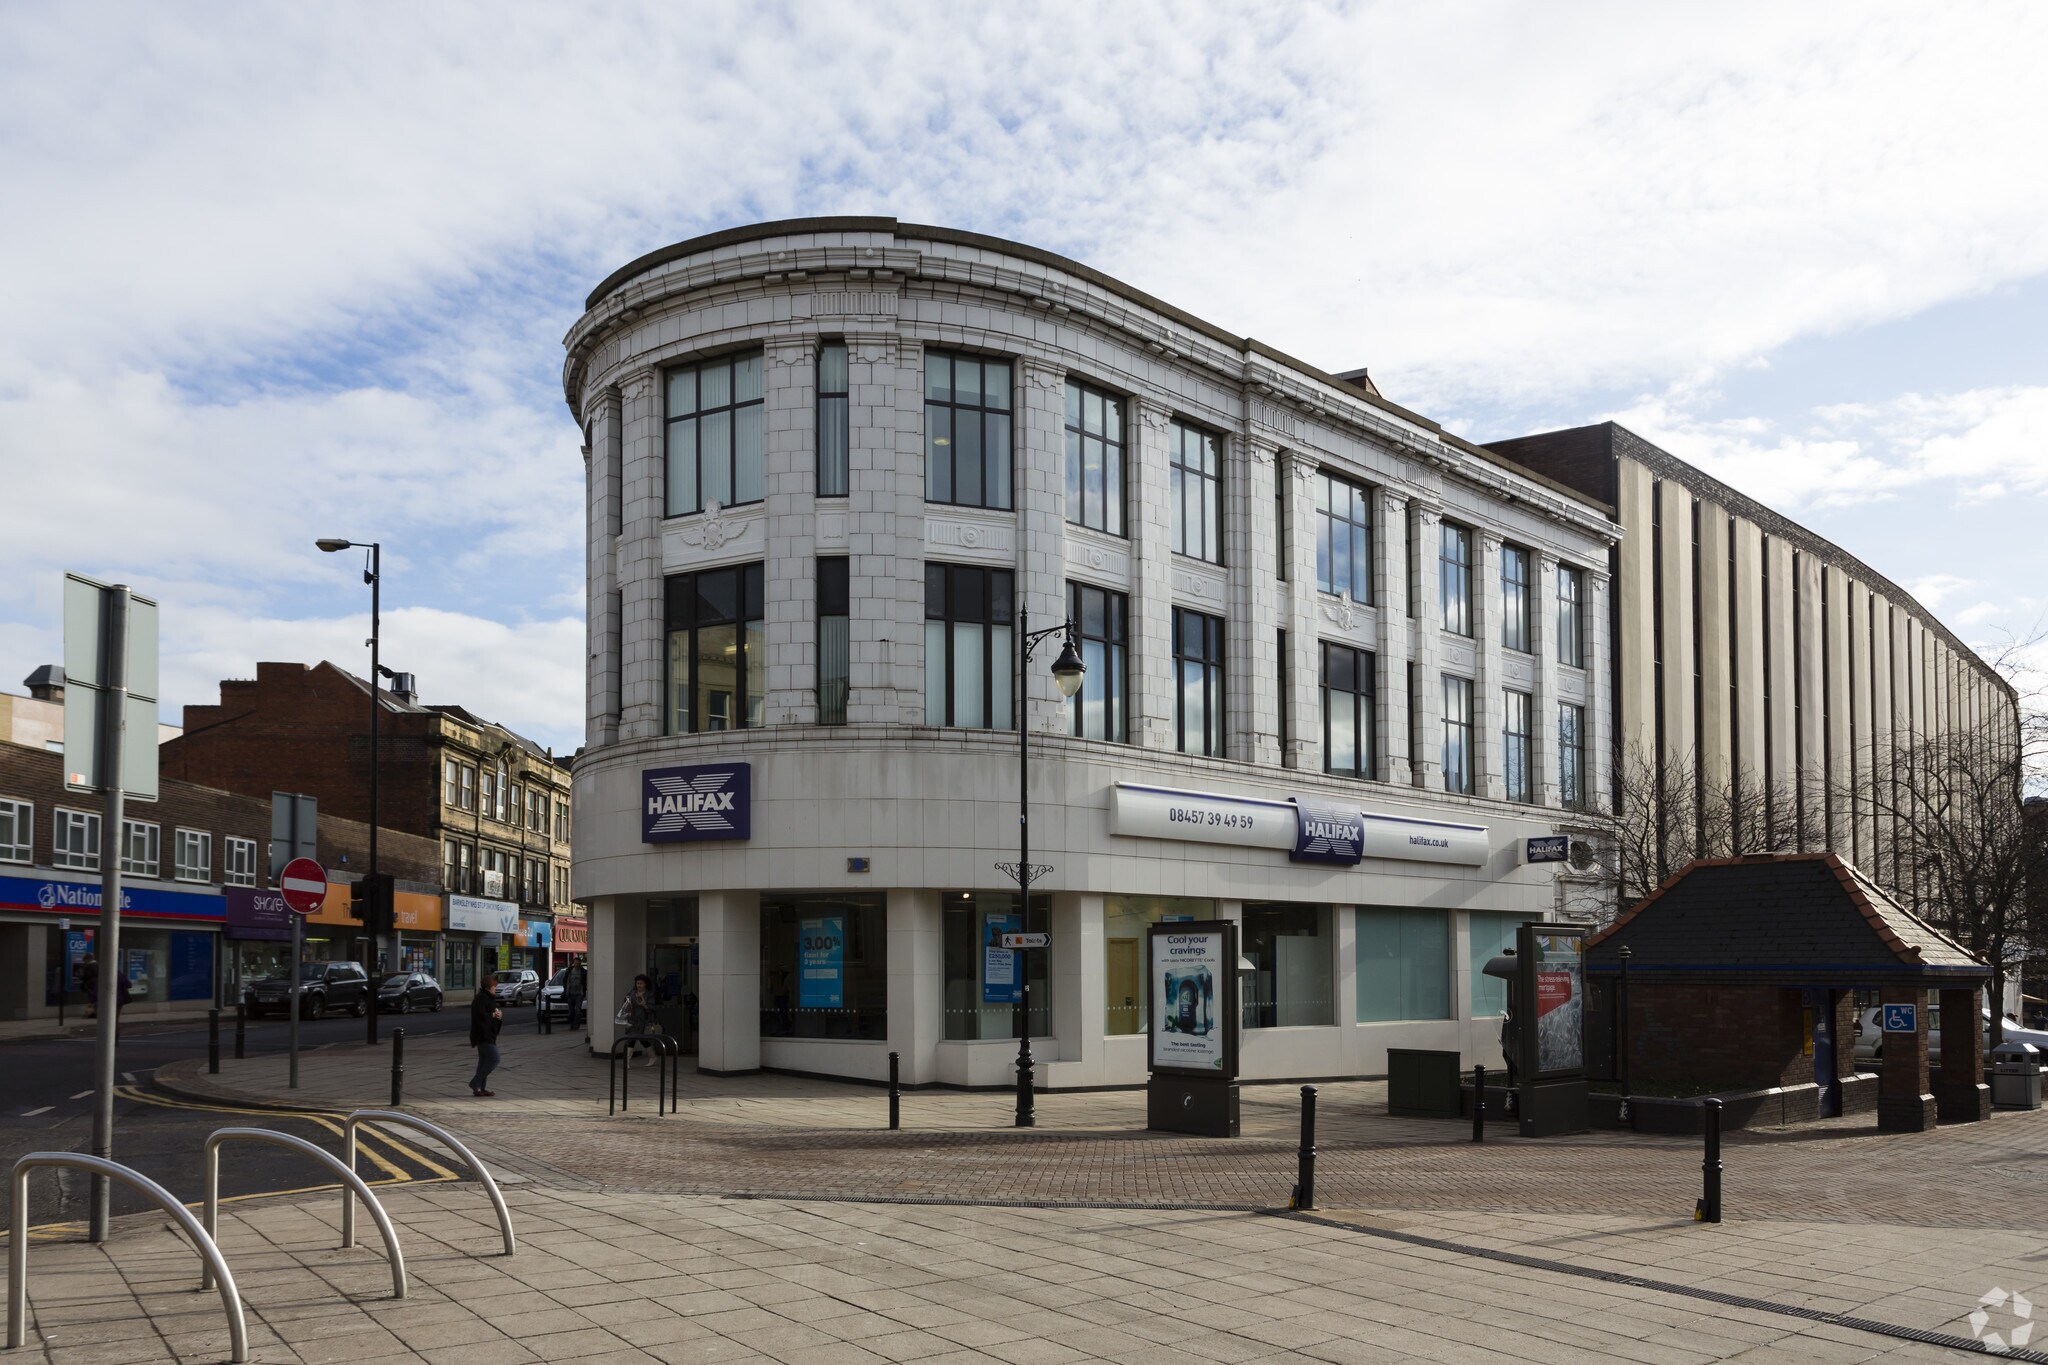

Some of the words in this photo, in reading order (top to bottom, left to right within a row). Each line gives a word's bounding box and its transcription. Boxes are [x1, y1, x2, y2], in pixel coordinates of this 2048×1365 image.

[648, 792, 735, 815] HALIFAX
[1169, 808, 1204, 824] 08457
[1207, 811, 1220, 826] 39
[1224, 813, 1236, 828] 49
[1240, 815, 1254, 829] 59
[1305, 821, 1359, 841] HALIFAX
[1409, 835, 1449, 848] halifax.co.uk
[1529, 845, 1563, 854] HALIFAX
[56, 884, 131, 909] Nationde
[401, 910, 417, 924] travel
[69, 940, 87, 950] CASH
[1167, 935, 1187, 944] Cool
[1188, 936, 1208, 945] your
[1170, 945, 1206, 956] cravings
